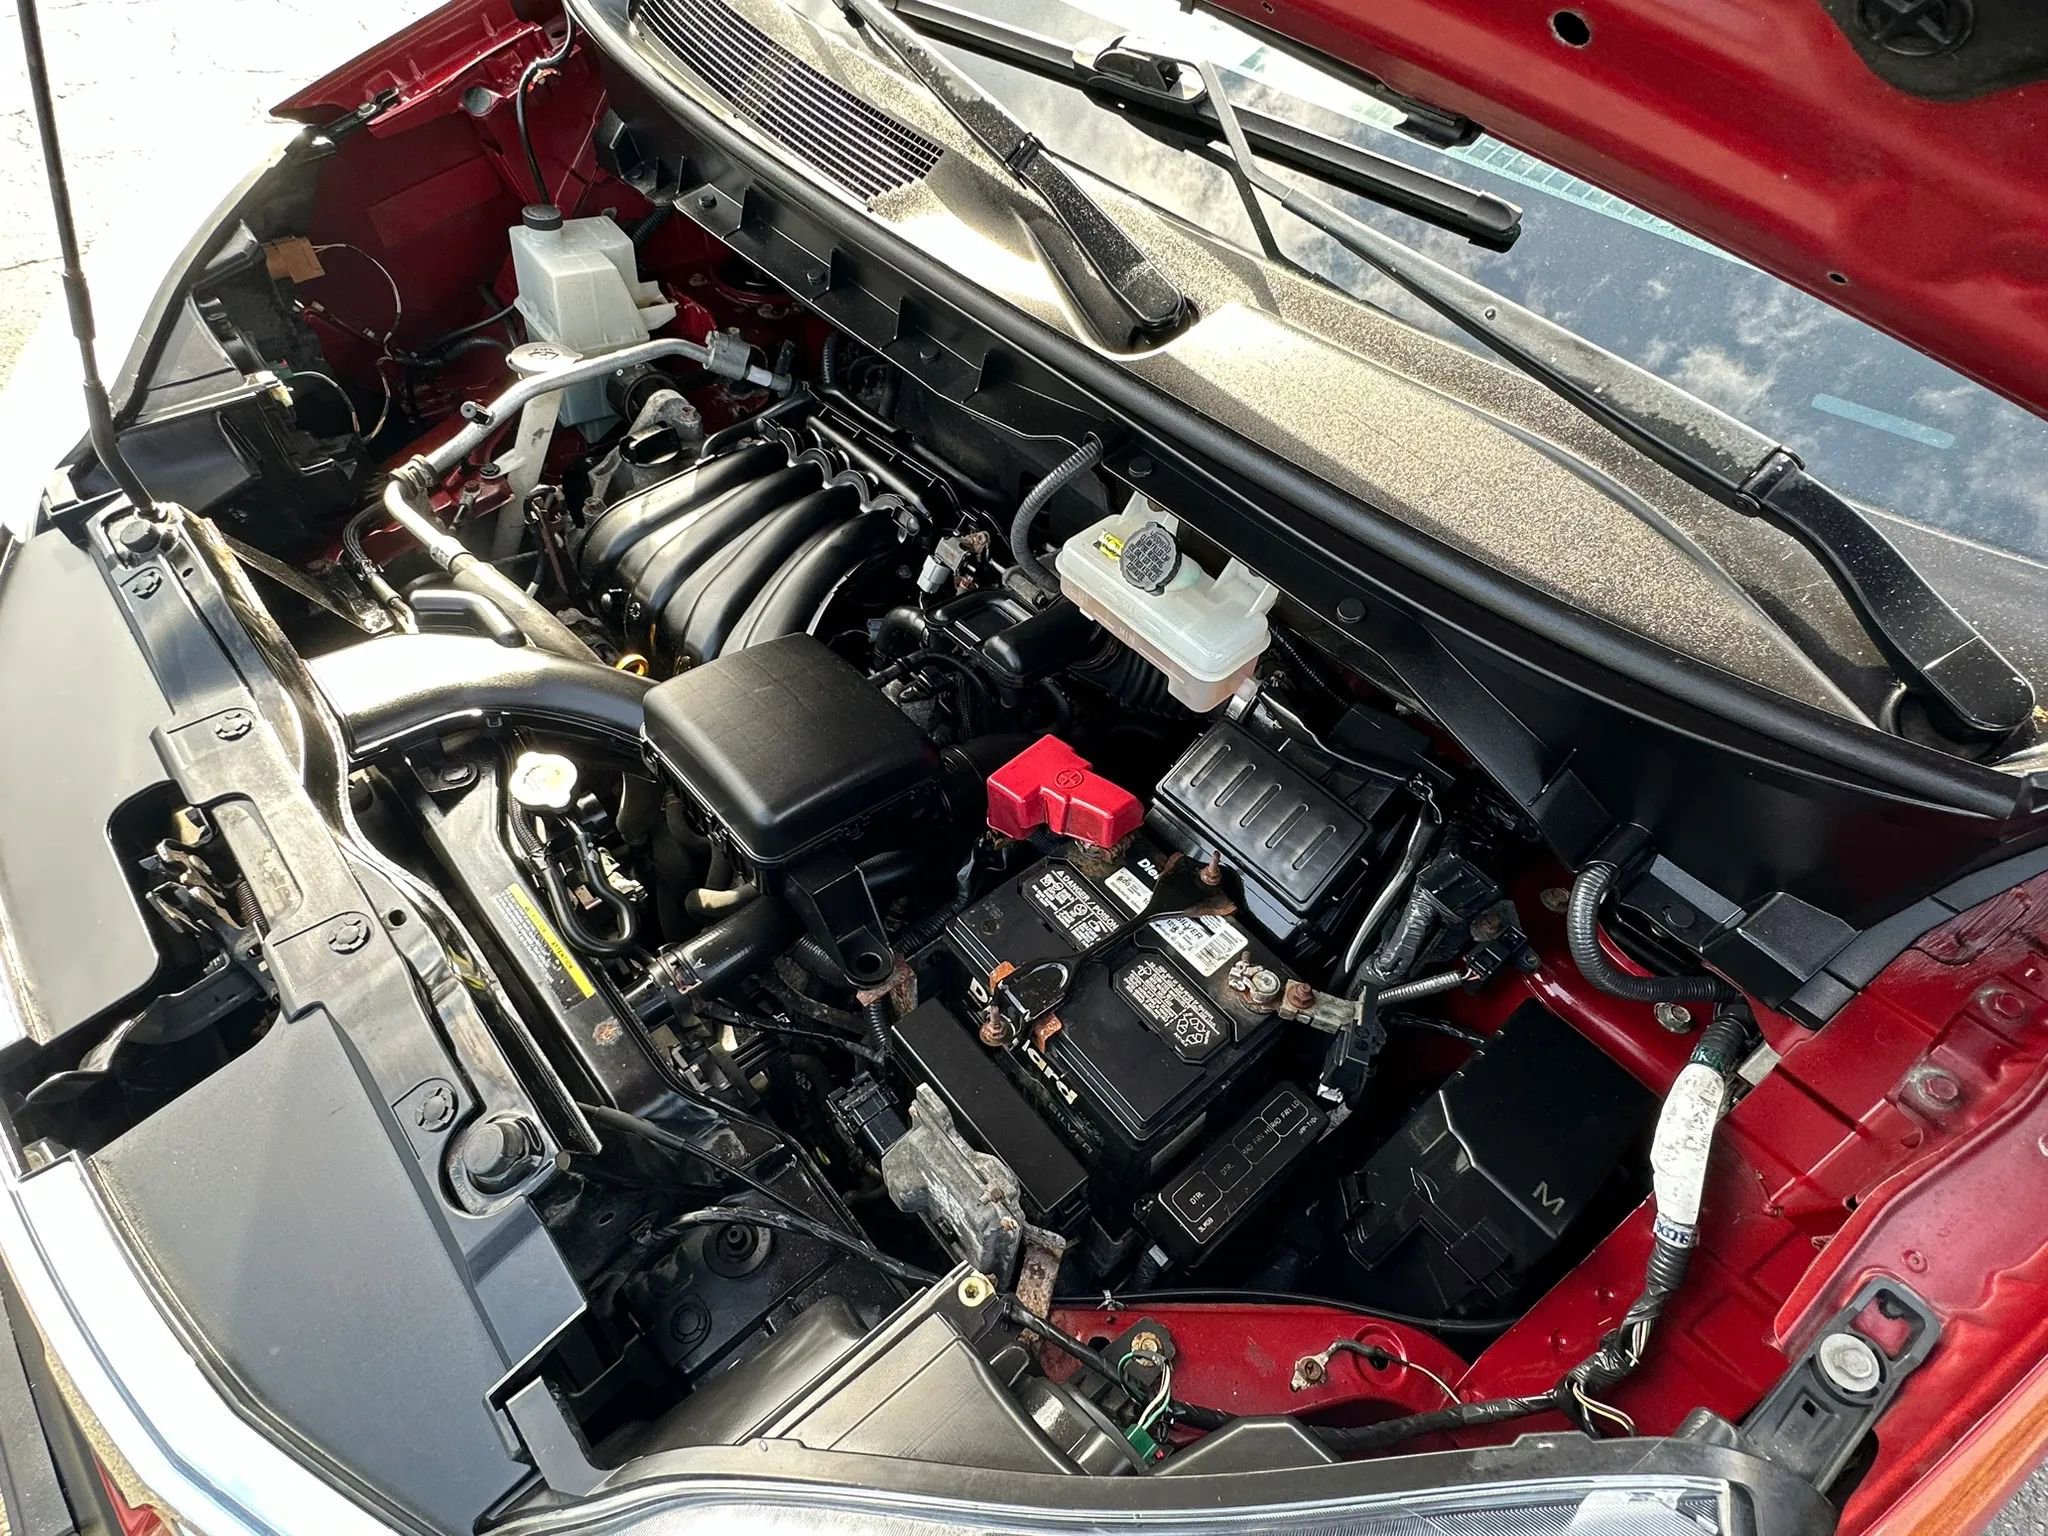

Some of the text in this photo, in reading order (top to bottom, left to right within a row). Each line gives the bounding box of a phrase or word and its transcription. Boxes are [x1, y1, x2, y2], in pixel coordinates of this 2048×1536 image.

[1062, 875, 1090, 901] DANGER
[1092, 905, 1119, 930] POISON
[1531, 1181, 1566, 1216] M
